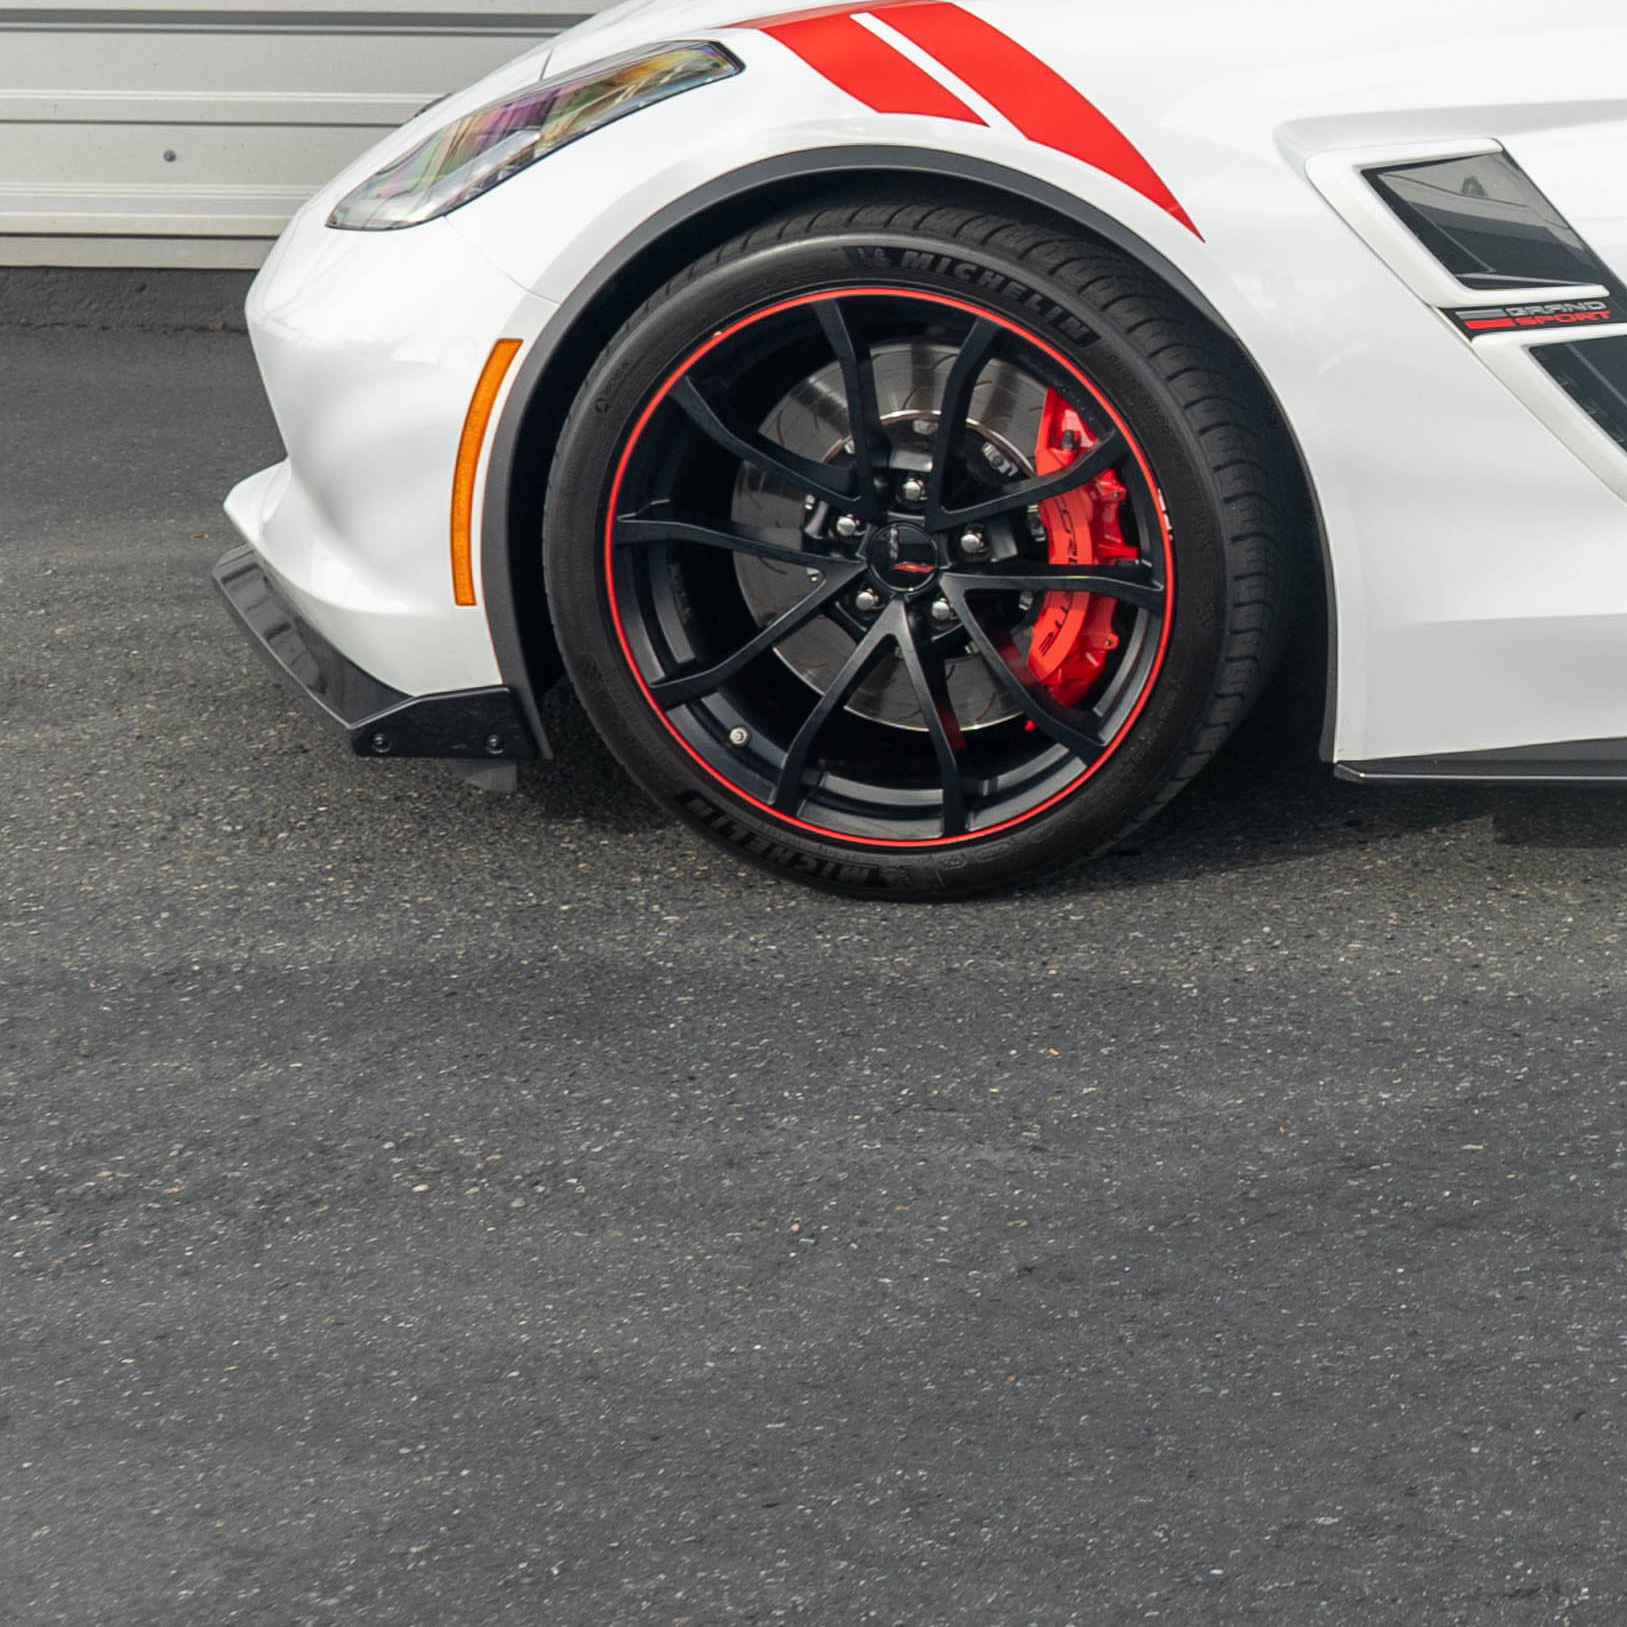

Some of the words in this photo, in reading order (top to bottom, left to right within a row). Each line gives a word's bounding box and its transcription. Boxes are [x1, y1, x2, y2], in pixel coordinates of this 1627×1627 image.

[904, 250, 1092, 343] MICHELIN
[1506, 301, 1607, 317] GRAND
[1515, 310, 1612, 326] SPORT
[686, 797, 870, 883] MICHELIN
